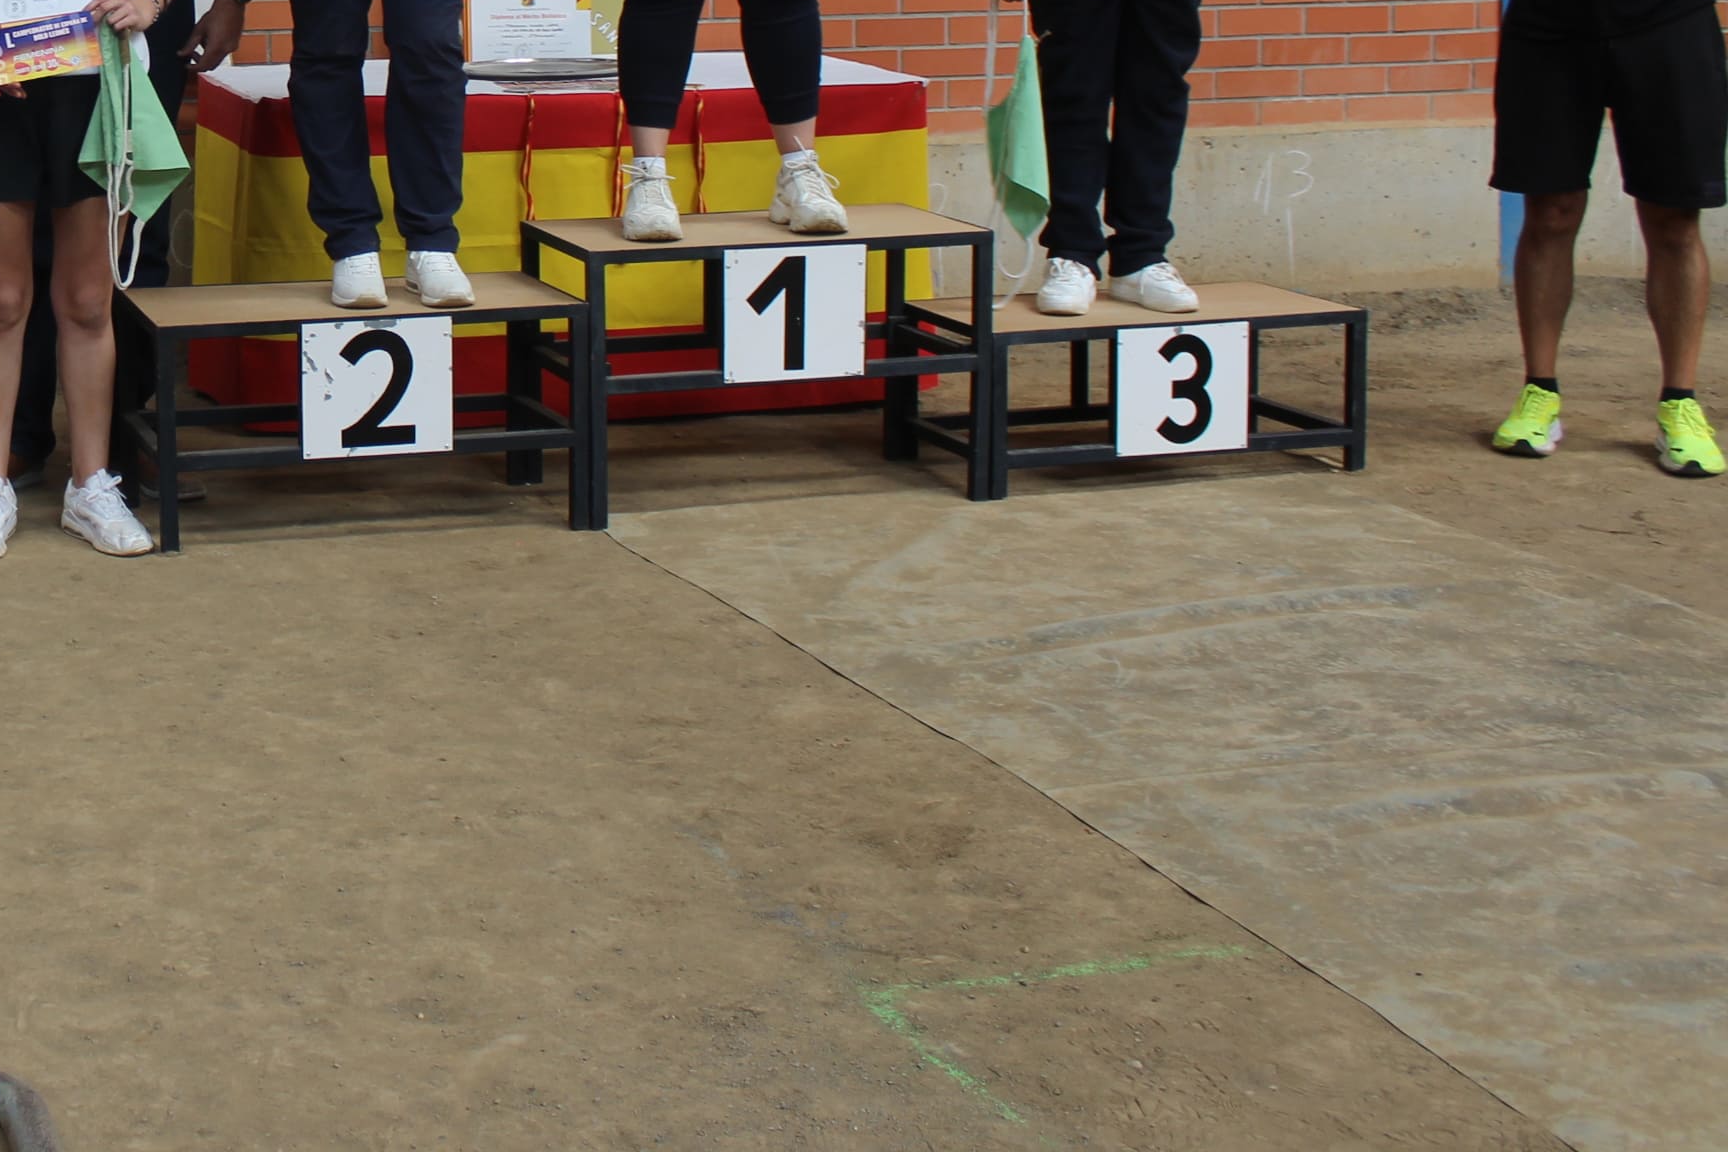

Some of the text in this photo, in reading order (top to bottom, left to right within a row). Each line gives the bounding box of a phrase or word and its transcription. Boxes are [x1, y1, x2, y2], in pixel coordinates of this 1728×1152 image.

[746, 255, 806, 371] 1
[340, 329, 416, 449] 2
[1156, 333, 1213, 444] 3
